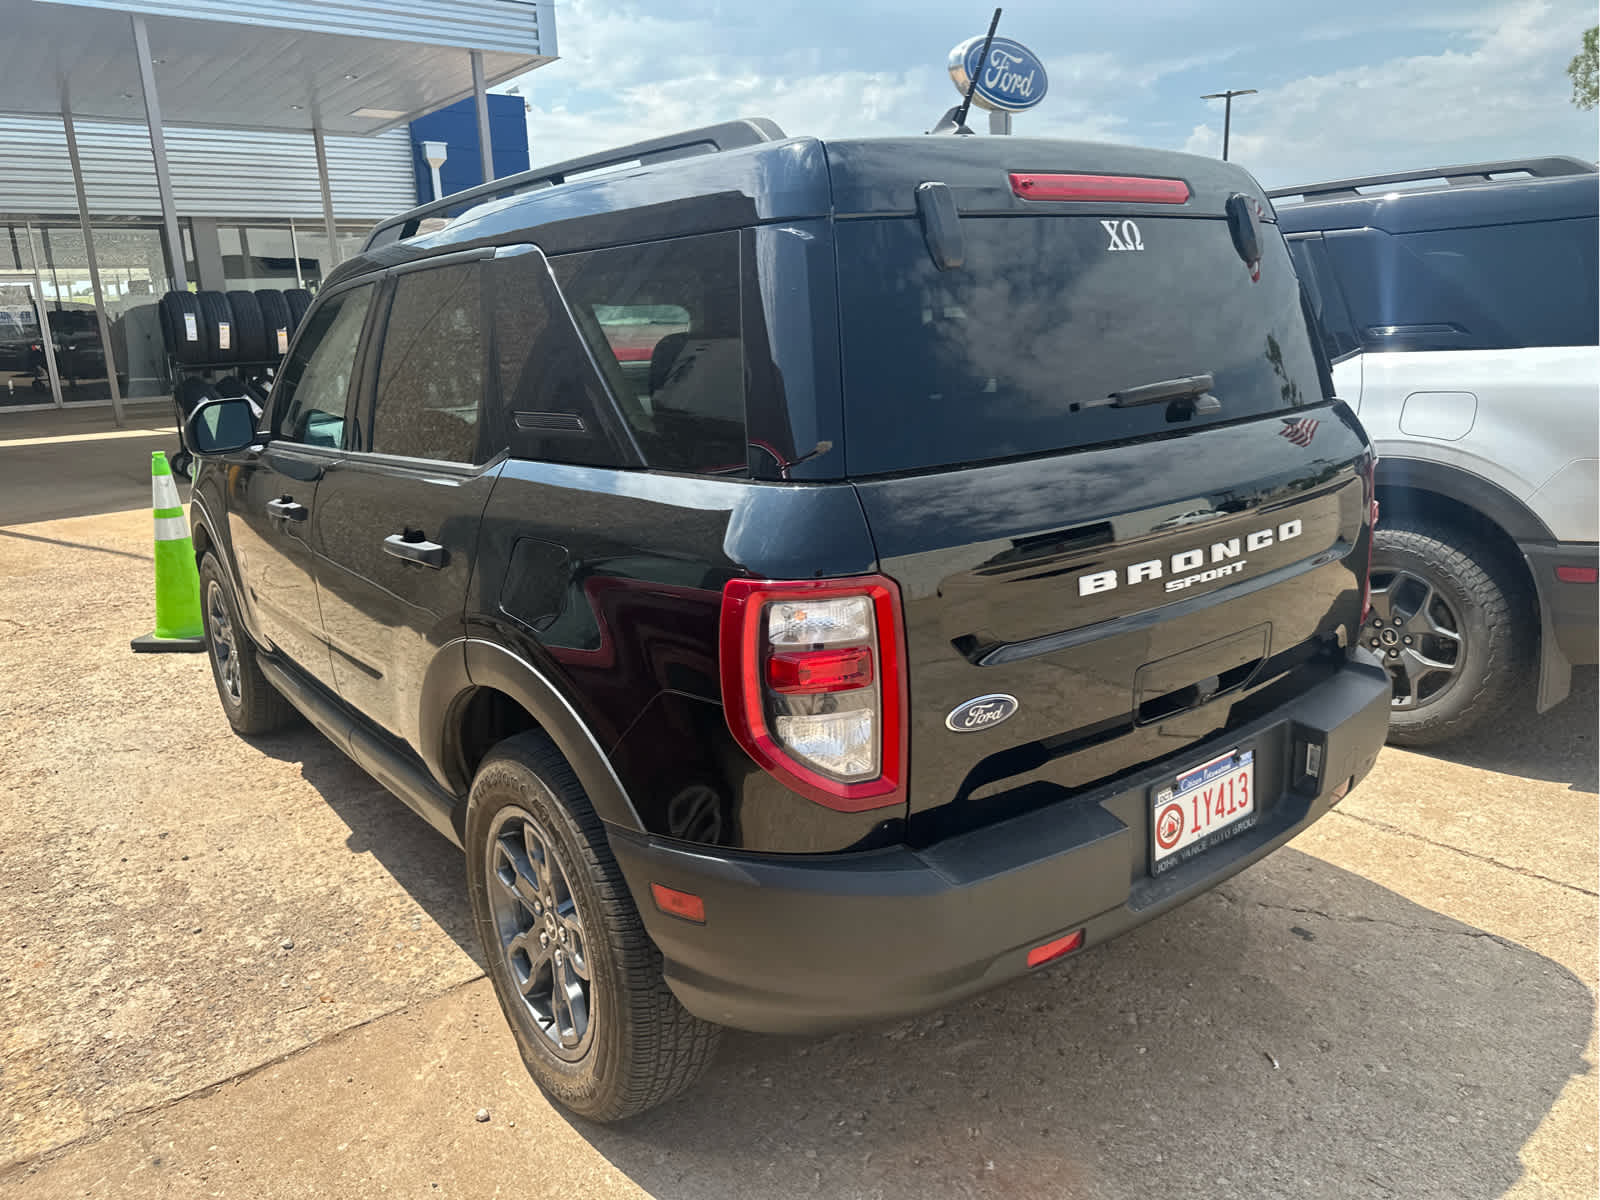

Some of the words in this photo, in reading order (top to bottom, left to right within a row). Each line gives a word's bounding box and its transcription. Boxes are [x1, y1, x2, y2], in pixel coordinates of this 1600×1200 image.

[985, 49, 1035, 97] Ford
[1078, 519, 1302, 597] BRONCO
[1164, 560, 1247, 593] SPORT
[964, 702, 1004, 727] Ford
[1191, 772, 1249, 834] 1Y413
[1155, 856, 1178, 874] JOHN
[1210, 830, 1231, 846] AUTO
[1232, 815, 1258, 835] GROUP
